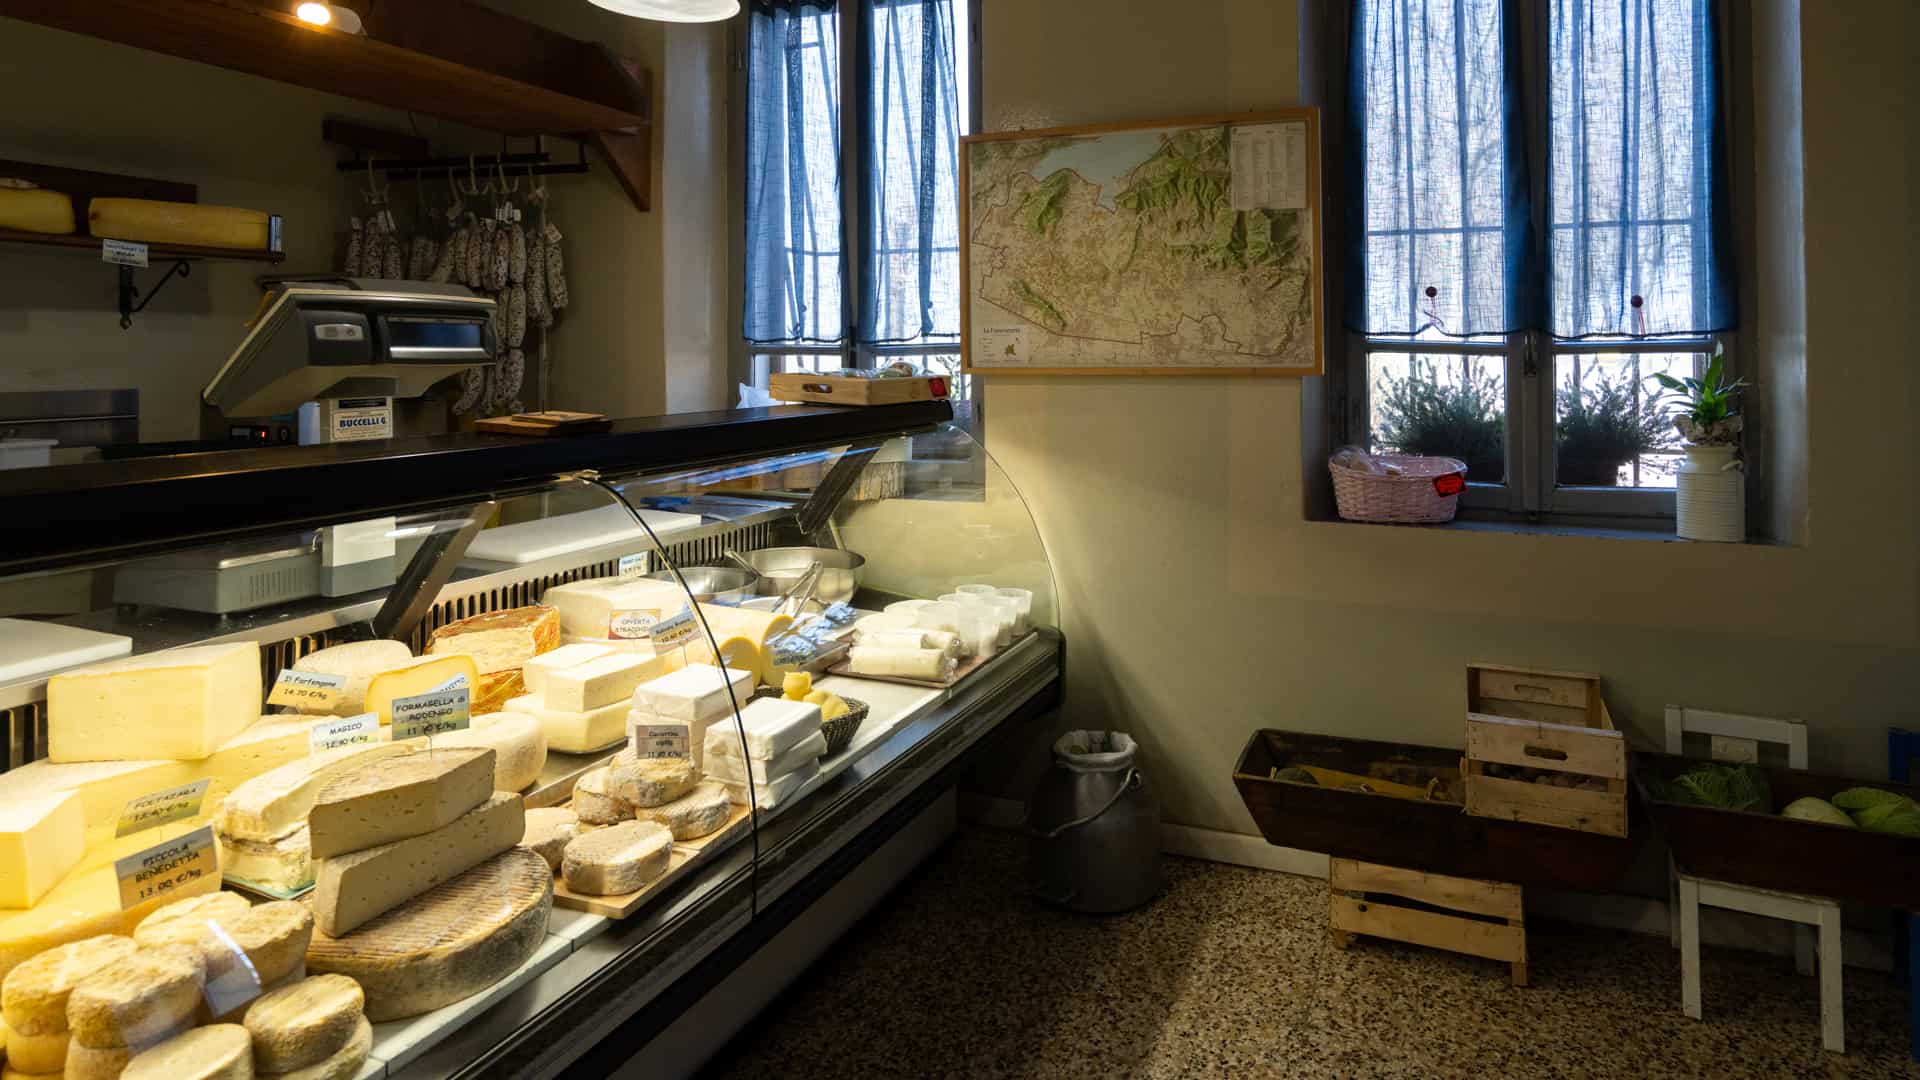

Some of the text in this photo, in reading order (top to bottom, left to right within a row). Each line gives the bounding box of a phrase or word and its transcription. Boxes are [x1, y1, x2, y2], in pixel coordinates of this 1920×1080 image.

[339, 417, 379, 428] BUCCELLI
[135, 851, 200, 883] BENEDETTA
[143, 843, 189, 867] PICCOLA
